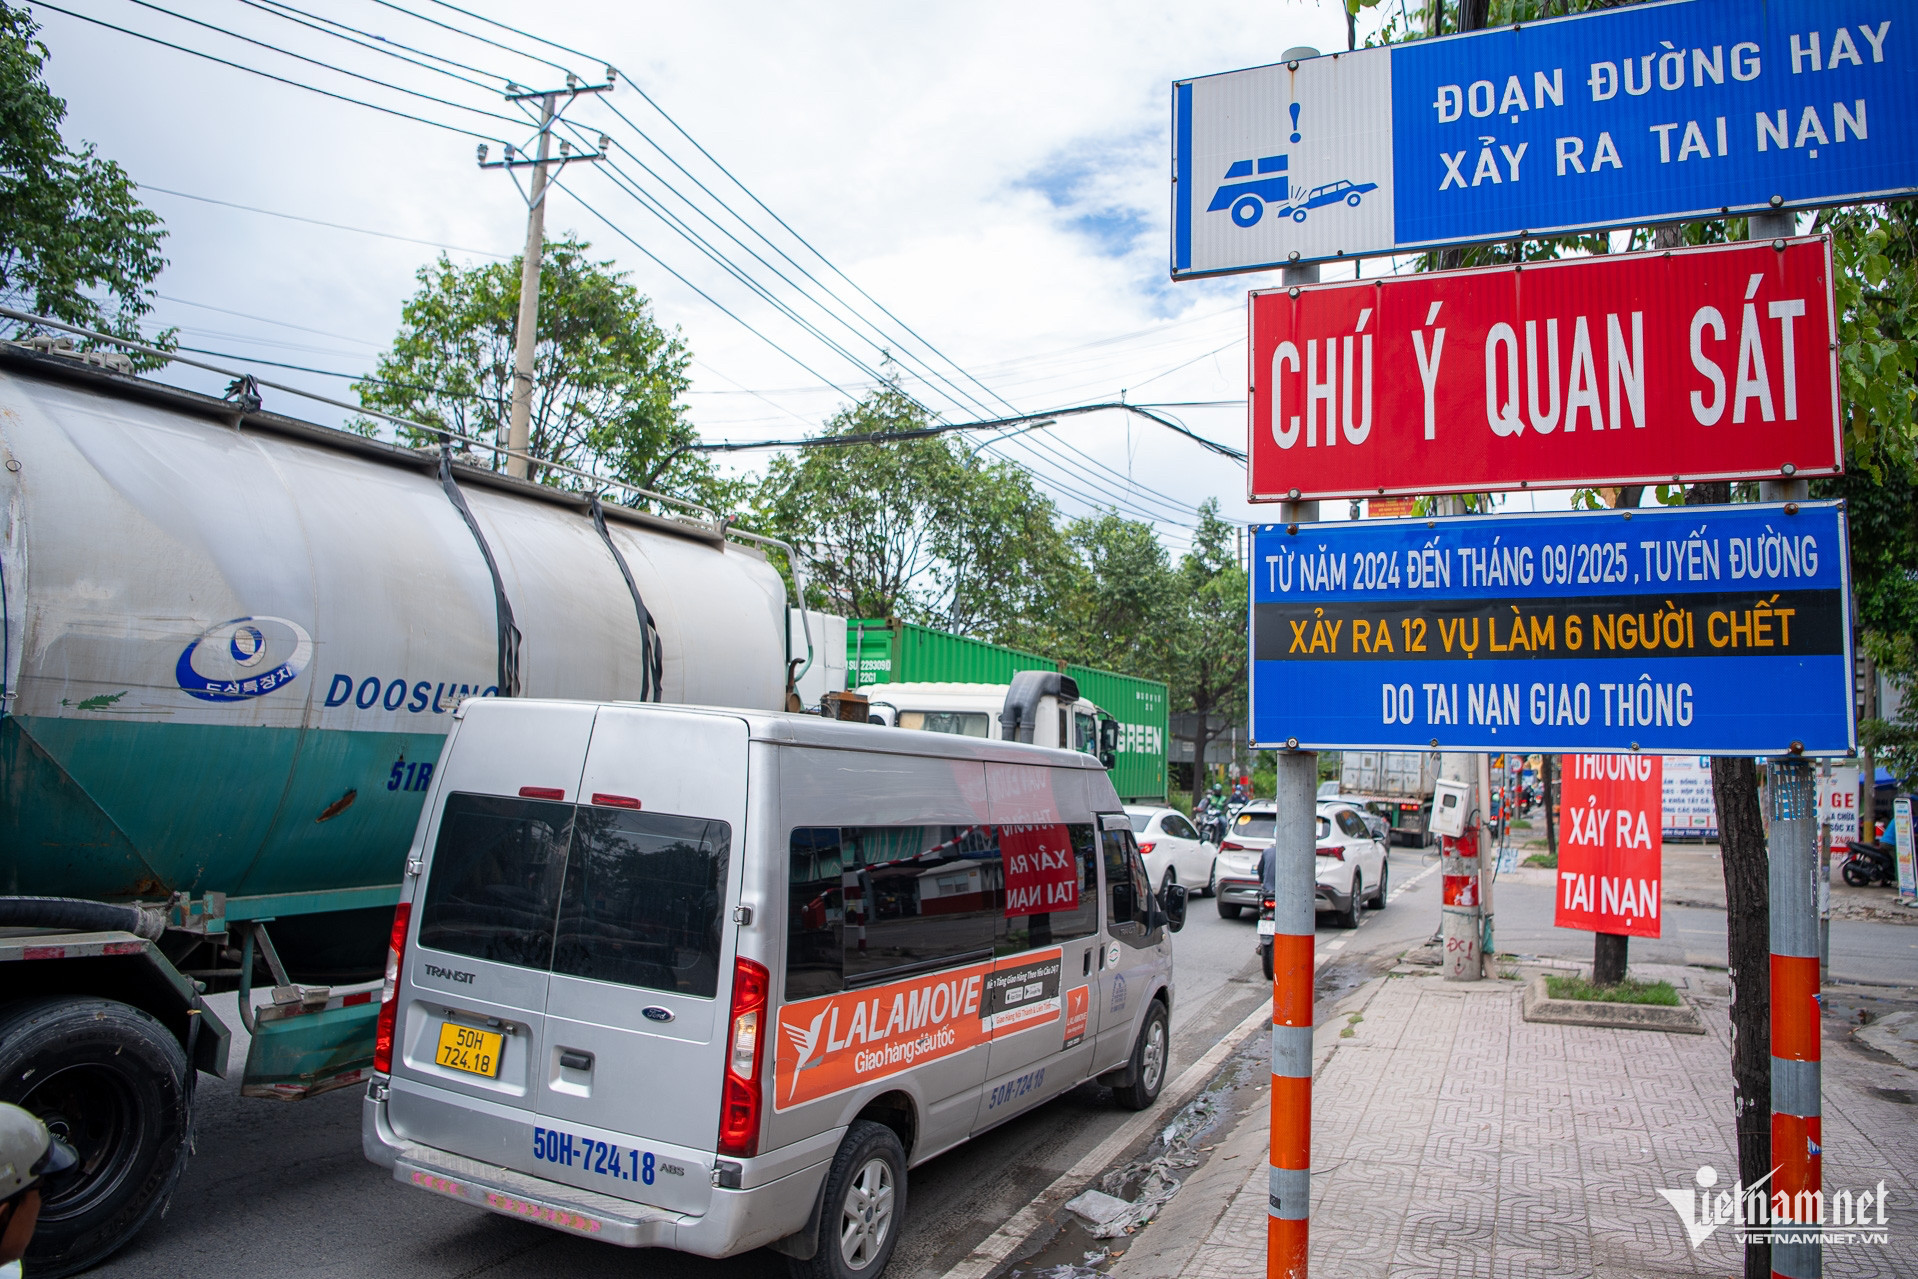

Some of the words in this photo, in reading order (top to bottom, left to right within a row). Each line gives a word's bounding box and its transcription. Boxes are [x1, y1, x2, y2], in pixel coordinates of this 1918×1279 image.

[1433, 67, 1565, 125] ĐOẠN
[1588, 40, 1761, 102] ĐƯỜNG
[1790, 20, 1893, 75] HAY
[1439, 136, 1530, 191] XẢY
[1556, 132, 1623, 177] RA
[1650, 116, 1728, 164] TAI
[1756, 99, 1868, 159] NẠN
[1271, 308, 1373, 449] CHÚ
[1411, 301, 1447, 440] Ý
[1484, 310, 1647, 438] QUAN
[1689, 273, 1806, 427] SÁT
[1265, 548, 1295, 593] TỪ
[1300, 544, 1347, 591] NĂM
[1353, 550, 1400, 588] 2024
[1407, 537, 1451, 587] ĐẾN
[1457, 536, 1535, 586] THÁNG
[1729, 524, 1819, 579] ĐƯỜNG
[1288, 608, 1343, 655] XẢY
[1352, 616, 1394, 653] RA
[1400, 615, 1427, 653] 12
[1438, 616, 1479, 659] VỤ
[1489, 605, 1555, 652] LÀM
[1564, 613, 1583, 651] 6
[1593, 599, 1695, 650] NGƯỜI
[1707, 594, 1797, 648] CHẾT
[1382, 683, 1415, 726] DO
[1422, 682, 1460, 726] TAI
[1468, 683, 1521, 734] NẠN
[1529, 681, 1591, 726] GIAO
[1599, 673, 1694, 727] THÔNG
[1567, 794, 1610, 849] XẢY
[1615, 809, 1653, 850] RA
[1560, 871, 1594, 912] TAI
[1598, 873, 1658, 926] NẠN
[424, 963, 476, 985] TRANSIT
[456, 1028, 484, 1051] 50H
[826, 974, 981, 1052] LALAMOVE
[444, 1046, 490, 1073] 724.18
[854, 1048, 884, 1074] Giao
[533, 1126, 655, 1186] 50H-724.18
[659, 1163, 685, 1176] ABS
